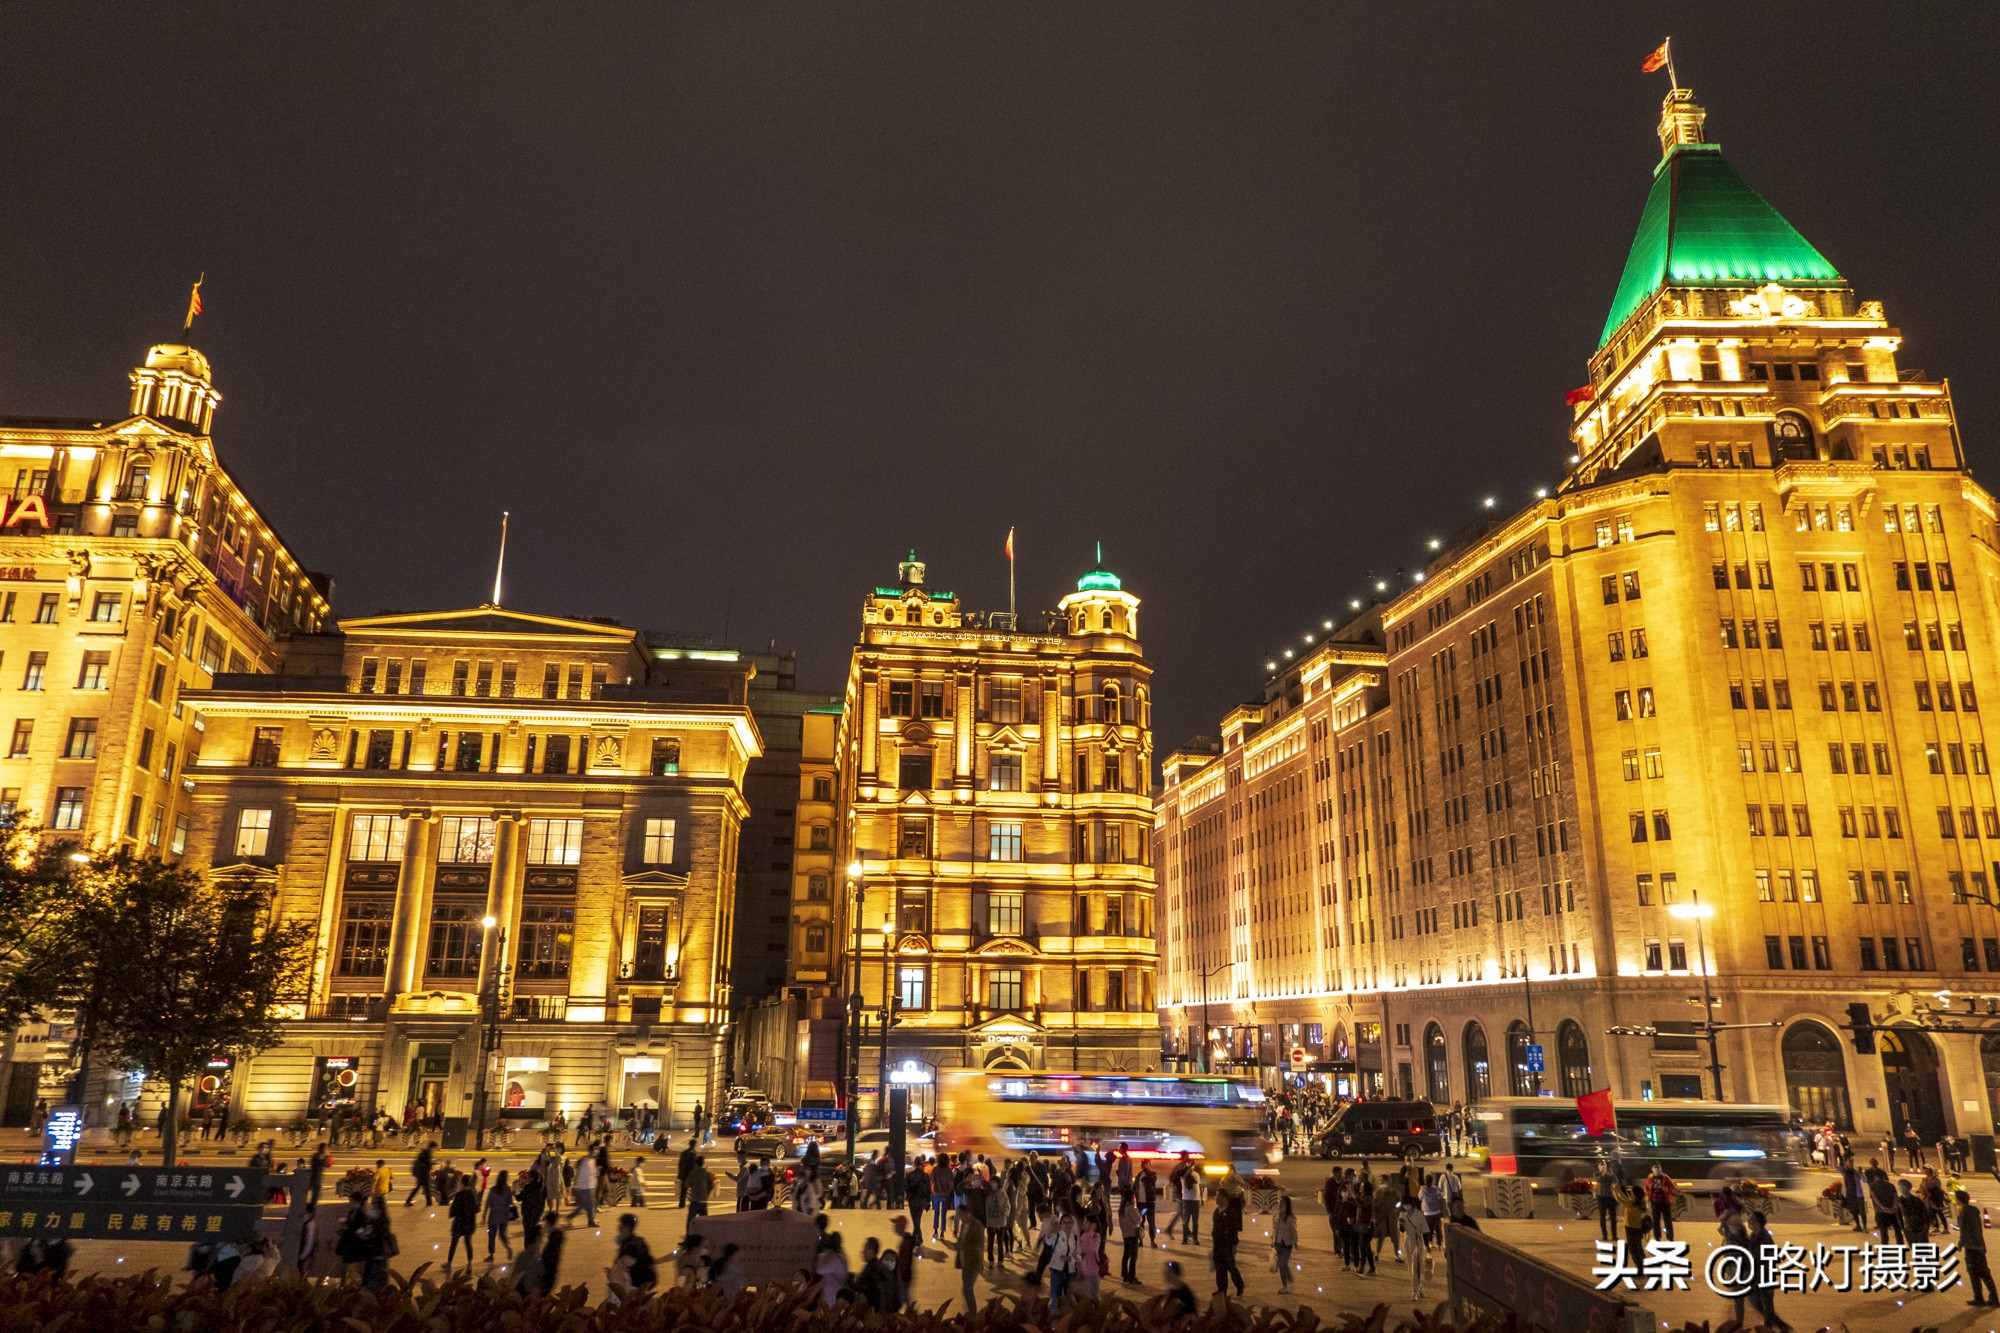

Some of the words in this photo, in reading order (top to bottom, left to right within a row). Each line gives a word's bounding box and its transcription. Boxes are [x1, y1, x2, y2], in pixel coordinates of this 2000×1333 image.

[902, 631, 952, 640] SWATCH
[955, 633, 982, 641] ART
[8, 1171, 64, 1185] 南京东路
[155, 1174, 213, 1188] 南京东路
[107, 1213, 223, 1233] 民族有希望
